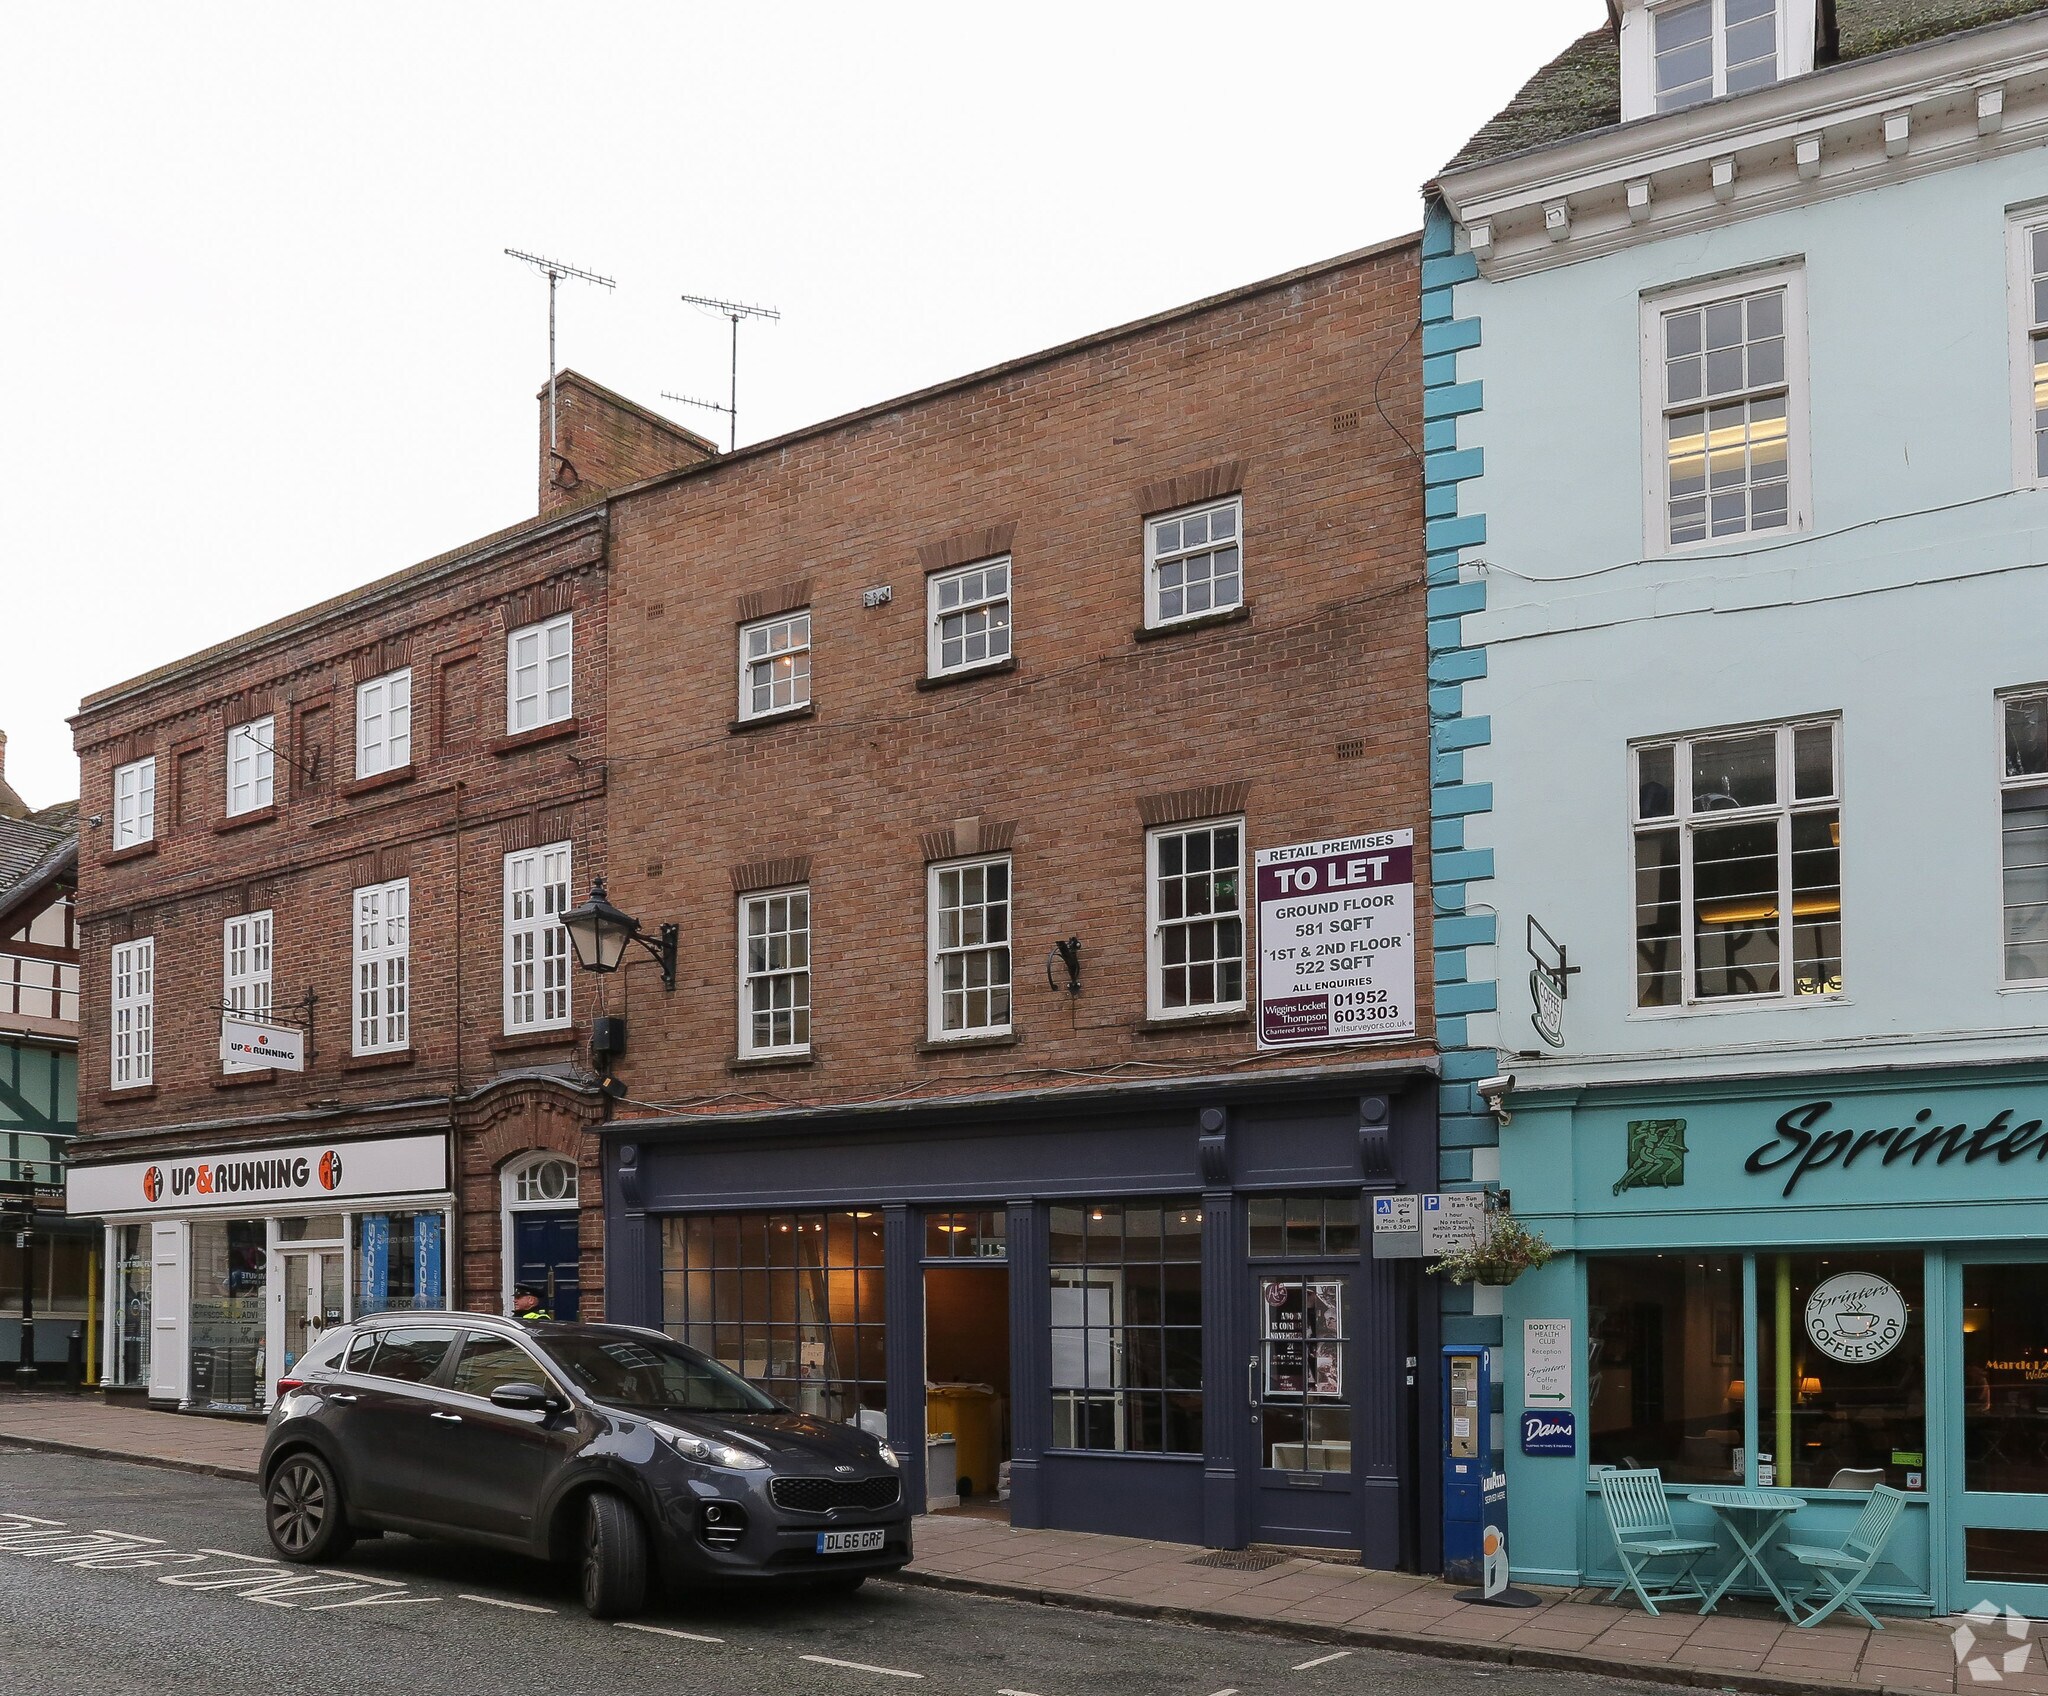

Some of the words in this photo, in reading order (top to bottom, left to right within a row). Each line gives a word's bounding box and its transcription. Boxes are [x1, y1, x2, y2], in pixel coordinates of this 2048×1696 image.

[1269, 846, 1318, 862] RETAIL
[1322, 834, 1394, 854] PREMISES
[1274, 866, 1318, 893] TO
[1327, 855, 1389, 887] LET
[1275, 901, 1339, 920] GROUND
[1343, 894, 1395, 912] FLOOR
[1295, 921, 1323, 937] 581
[1329, 916, 1375, 934] SQFT
[1269, 947, 1296, 961] 1ST
[1300, 946, 1312, 958] &
[1316, 941, 1346, 957] 2ND
[1350, 936, 1402, 953] FLOOR
[1295, 960, 1325, 975] 522
[1329, 955, 1375, 973] SQFT
[1292, 983, 1312, 992] ALL
[1314, 977, 1373, 991] ENQUIRIES
[1333, 990, 1388, 1007] 01952
[1540, 982, 1560, 1014] COFFEE
[1265, 1004, 1297, 1016] Wiggins
[1298, 1001, 1326, 1012] Lockett
[1282, 1013, 1327, 1024] Thompson
[1333, 1005, 1399, 1023] 603303
[1266, 1026, 1296, 1036] Chartered
[1297, 1024, 1328, 1033] Surveyors
[1428, 1197, 1438, 1210] P
[1808, 1286, 1890, 1314] Sprinters
[1812, 1318, 1864, 1358] COFFEE
[1866, 1318, 1900, 1356] SHOP
[1527, 1364, 1566, 1378] Sprinters
[1986, 1361, 2039, 1370] Mardol
[1526, 1418, 1572, 1441] Dains
[827, 1534, 859, 1550] DL66
[862, 1532, 883, 1548] GRF
[157, 1568, 444, 1611] ONLY
